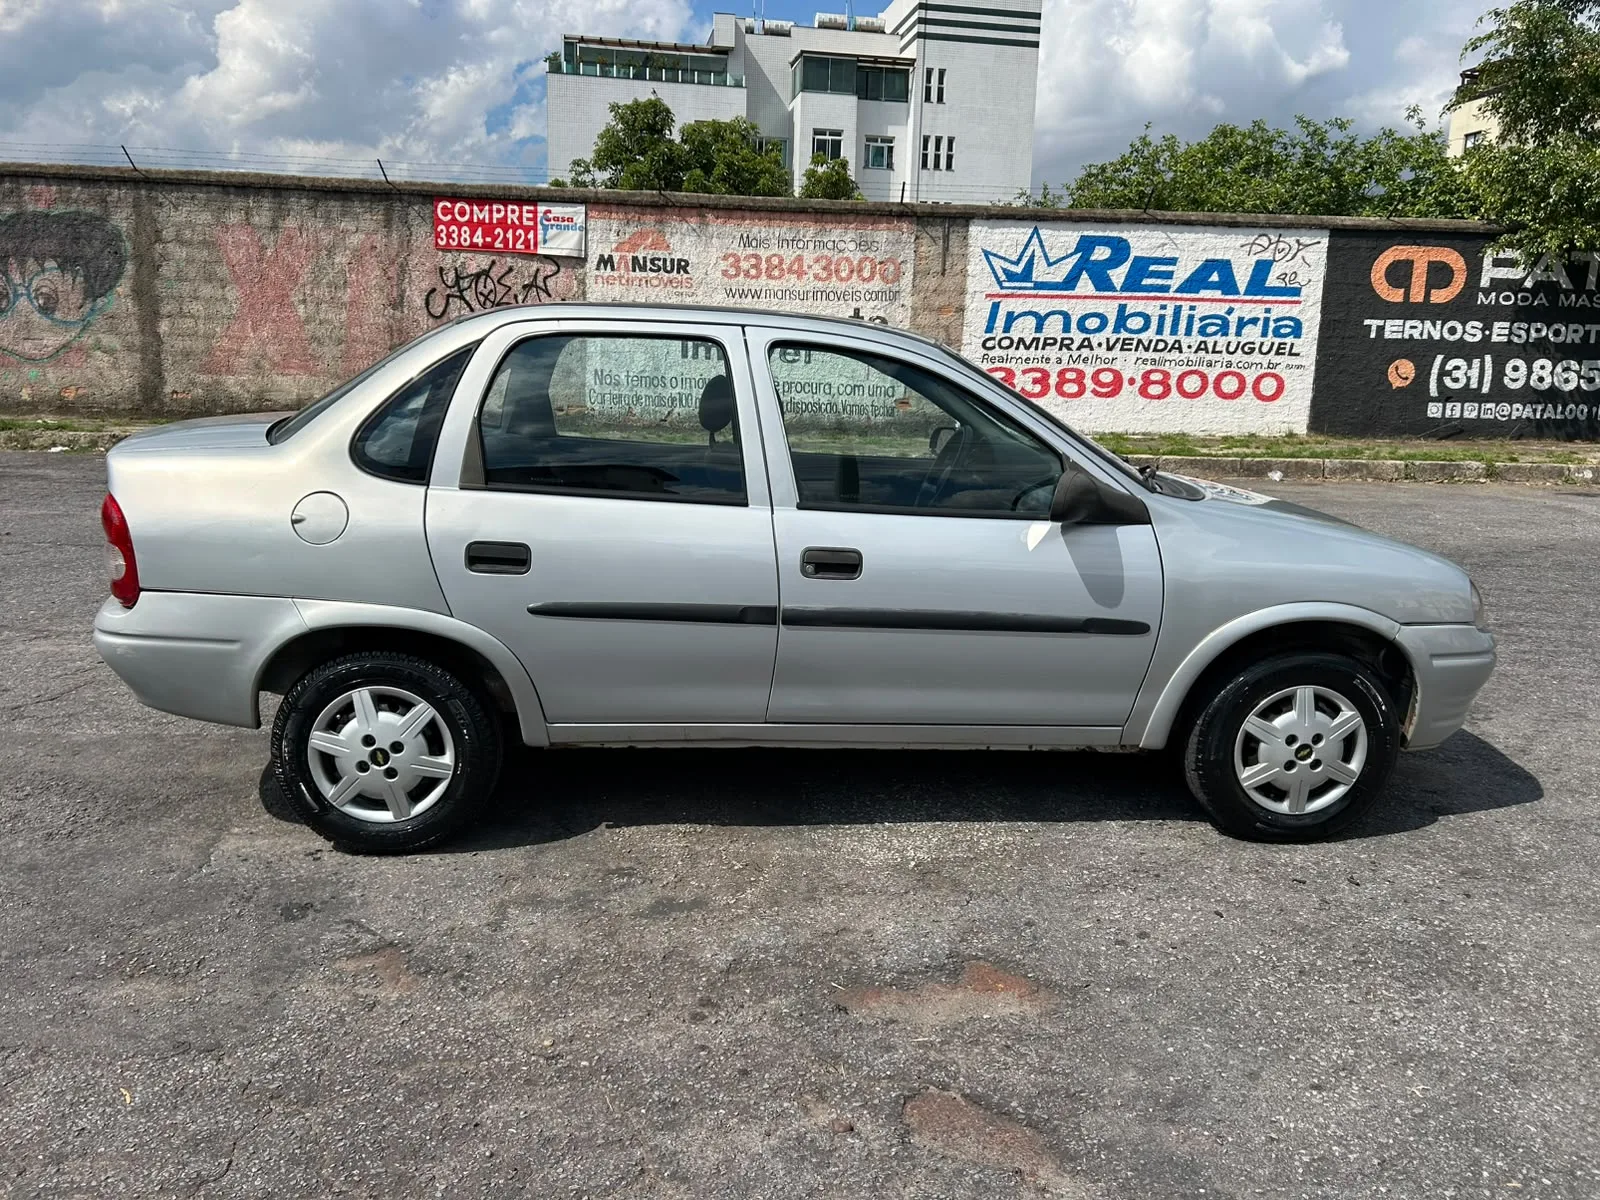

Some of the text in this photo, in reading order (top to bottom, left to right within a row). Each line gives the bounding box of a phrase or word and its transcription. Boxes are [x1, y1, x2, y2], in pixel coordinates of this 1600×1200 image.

[436, 200, 535, 226] COMPRE
[541, 209, 574, 223] Casa
[436, 224, 535, 250] 3384-2121
[738, 233, 771, 249] Mais
[595, 254, 690, 274] MANSUR
[1477, 291, 1549, 306] MODA
[984, 300, 1303, 339] Imobiliária
[1363, 319, 1484, 342] TERNOS
[981, 336, 1301, 357] COMPRA VENDA ALUGUEL
[981, 353, 1051, 365] Realmente
[1055, 355, 1063, 365] a
[1067, 353, 1118, 366] Melhor
[1134, 356, 1281, 370] realimobiliaria.com.br
[593, 368, 620, 386] Nós
[626, 370, 666, 388] temos
[670, 376, 678, 389] o
[1429, 354, 1600, 397] (31) 9865
[782, 379, 836, 398] procura,
[837, 382, 865, 397] com
[867, 383, 896, 398] uma
